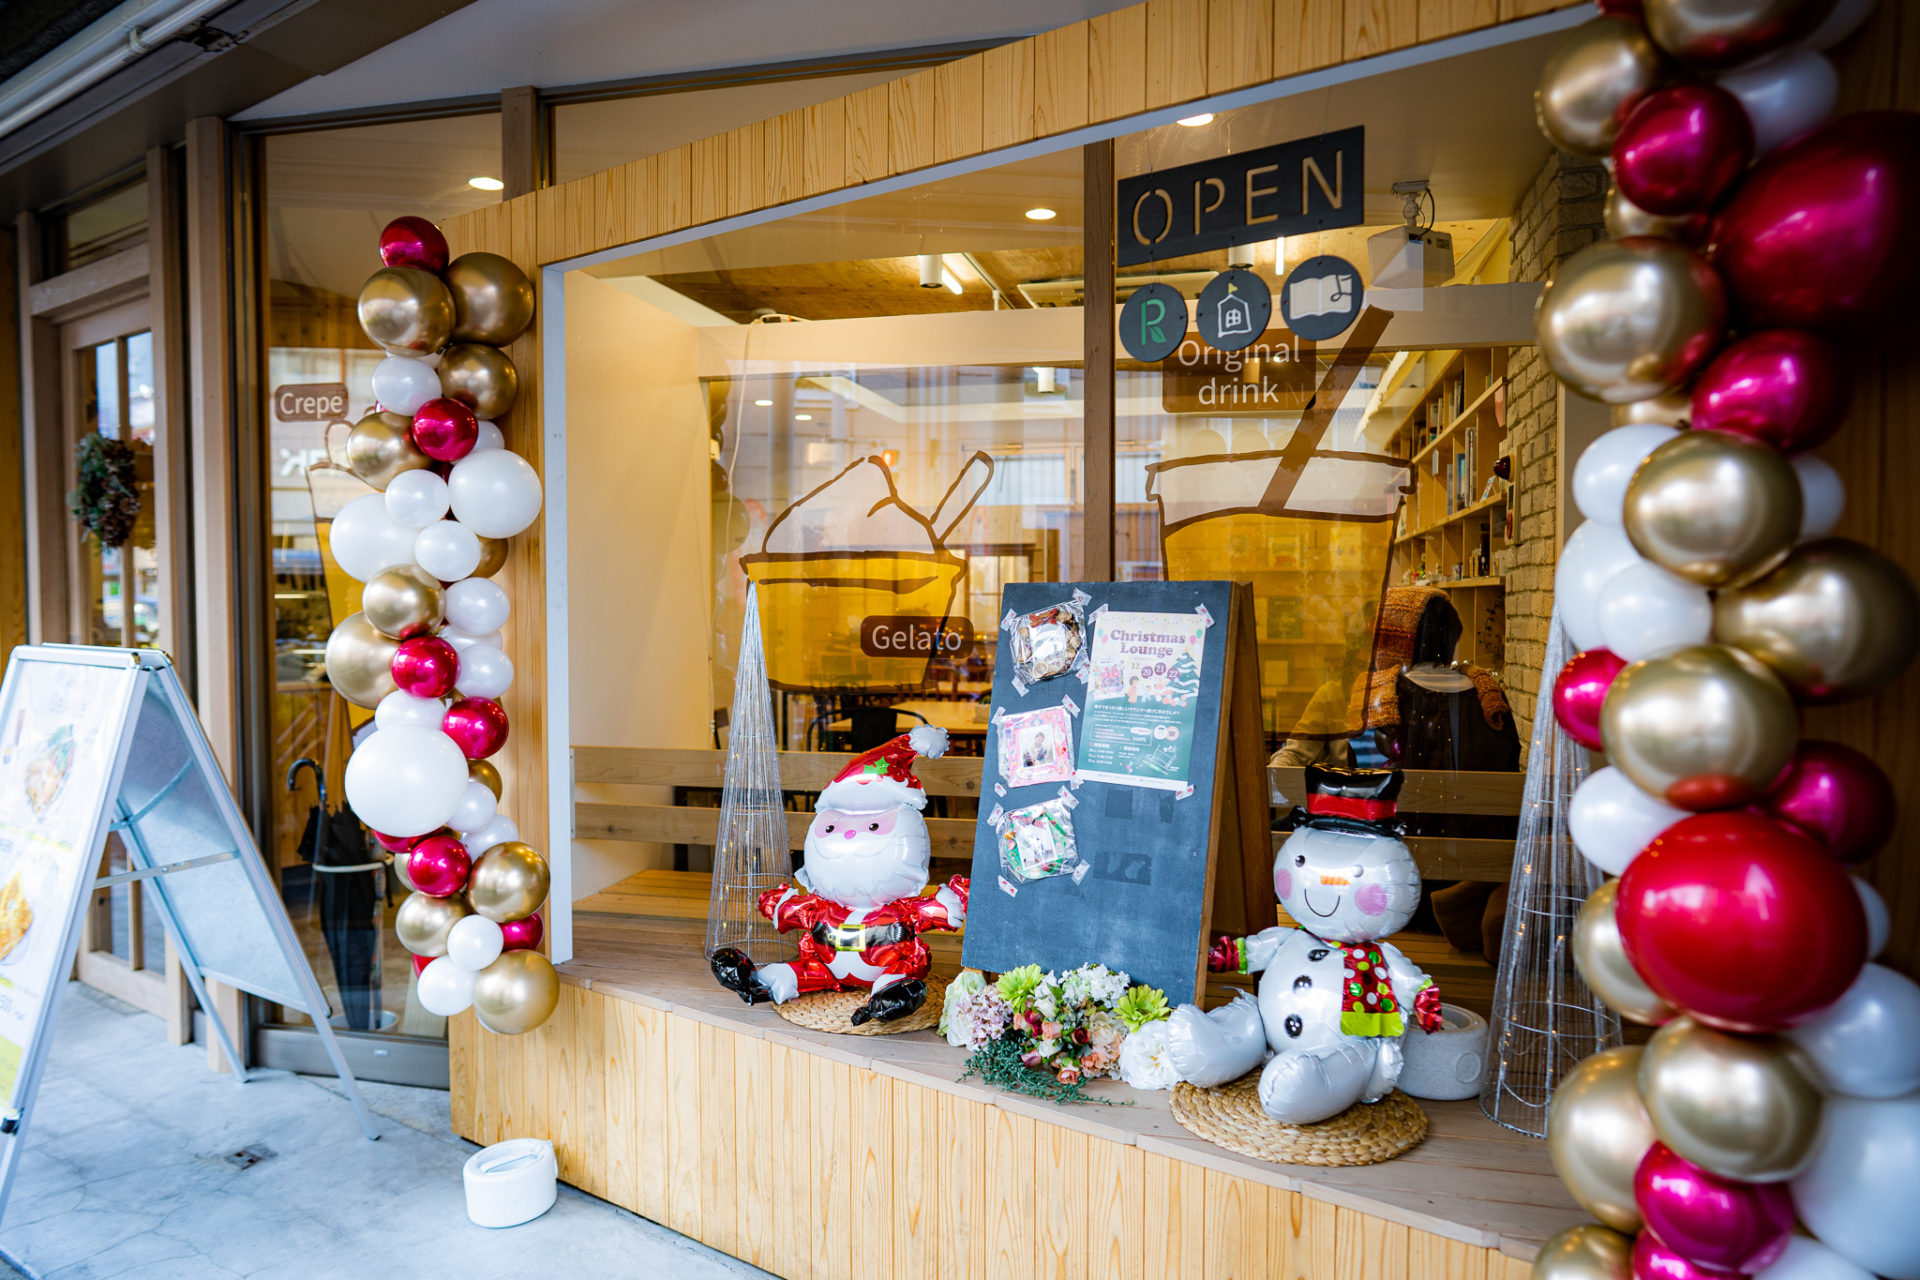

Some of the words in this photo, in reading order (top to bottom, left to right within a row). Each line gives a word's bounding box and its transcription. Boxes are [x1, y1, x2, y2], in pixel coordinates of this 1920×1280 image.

[1132, 149, 1343, 246] OPEN
[1178, 335, 1300, 373] Original
[1198, 375, 1280, 406] drink
[280, 392, 343, 420] Crepe
[872, 623, 962, 651] Gelato
[1110, 629, 1186, 644] Christmas
[1119, 642, 1174, 659] Lounge
[1156, 664, 1165, 673] 21
